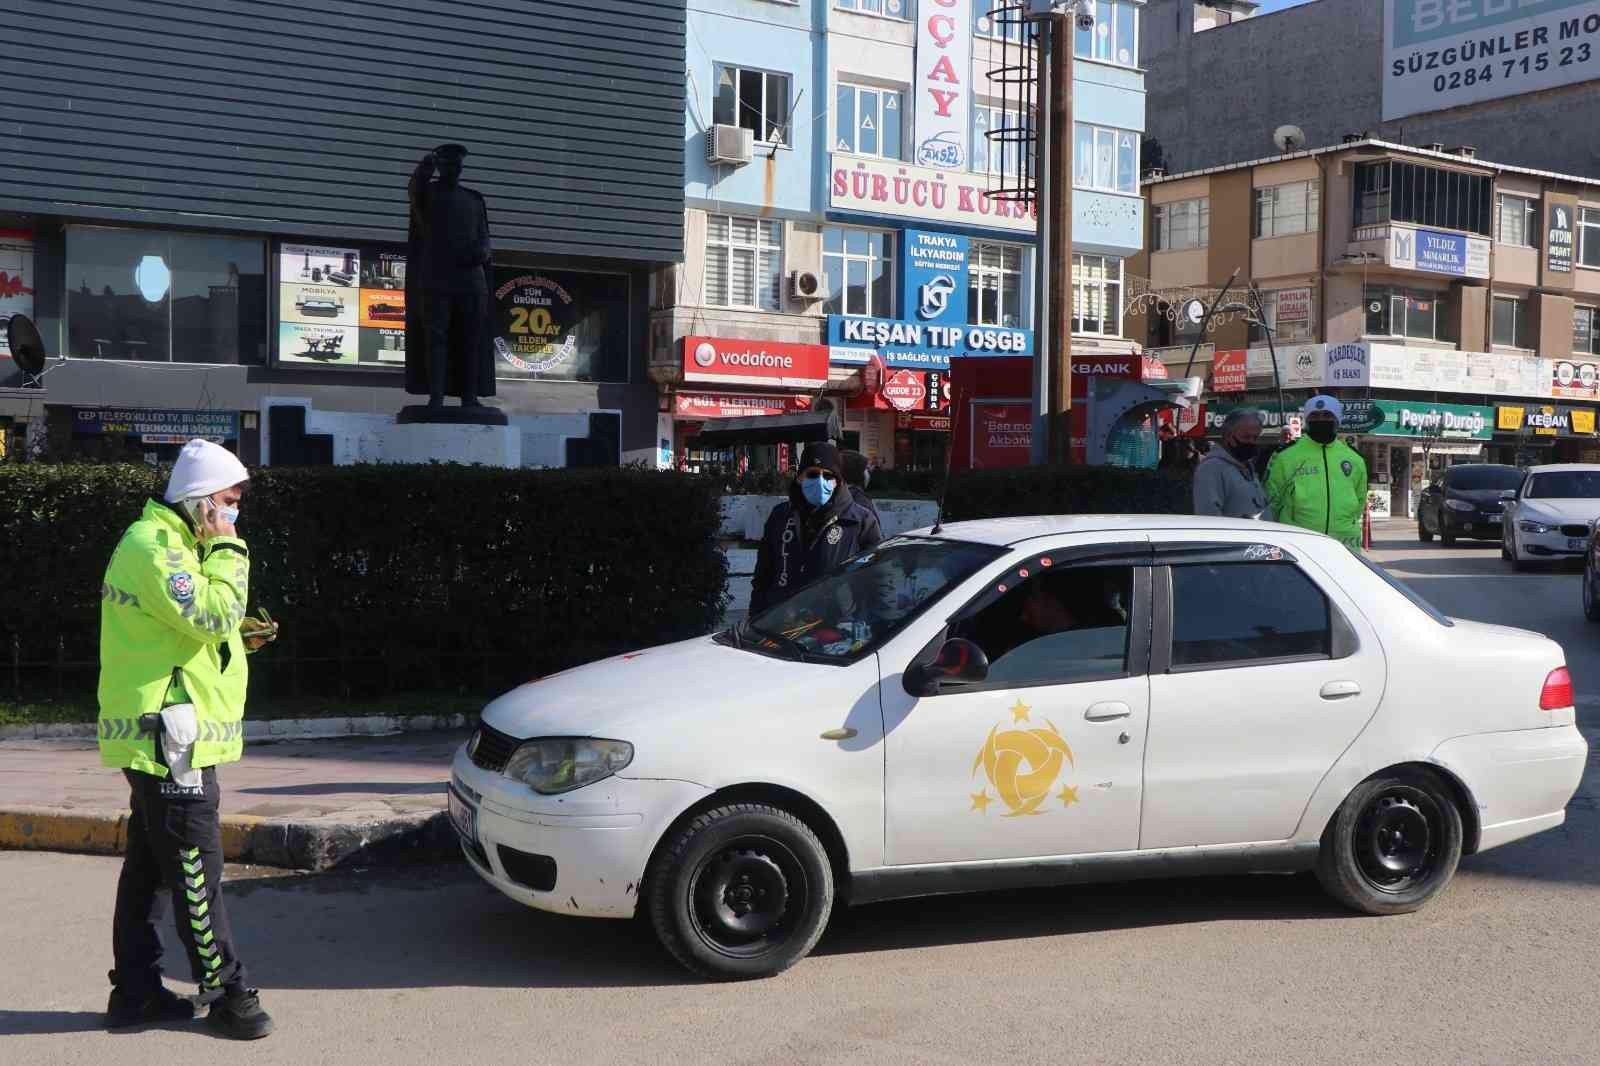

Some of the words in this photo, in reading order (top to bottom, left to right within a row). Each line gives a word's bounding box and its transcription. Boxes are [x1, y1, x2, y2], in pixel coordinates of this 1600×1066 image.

[927, 0, 961, 117] ÇAY
[1392, 26, 1549, 77] SÜZGÜNLER
[1433, 64, 1493, 93] 0284
[1502, 52, 1549, 79] 715
[1559, 43, 1592, 67] 23
[833, 162, 948, 210] SÜRÜCÜ
[910, 244, 965, 262] İLKYARDIM
[918, 234, 958, 248] TRAKYA
[1427, 236, 1457, 251] YILDIZ
[513, 294, 553, 305] ÜRÜNLER
[524, 287, 542, 297] TÜM
[510, 307, 551, 335] 20
[545, 325, 561, 335] AY
[844, 319, 921, 348] KEŞAN
[926, 326, 963, 347] TIP
[968, 330, 1026, 351] OSGB
[720, 351, 793, 369] vodafone
[896, 352, 929, 362] SAĞLIĞI
[931, 355, 942, 363] VE
[930, 373, 939, 409] ÇORBA
[1401, 408, 1441, 431] Peynir
[1443, 410, 1485, 435] Durağı
